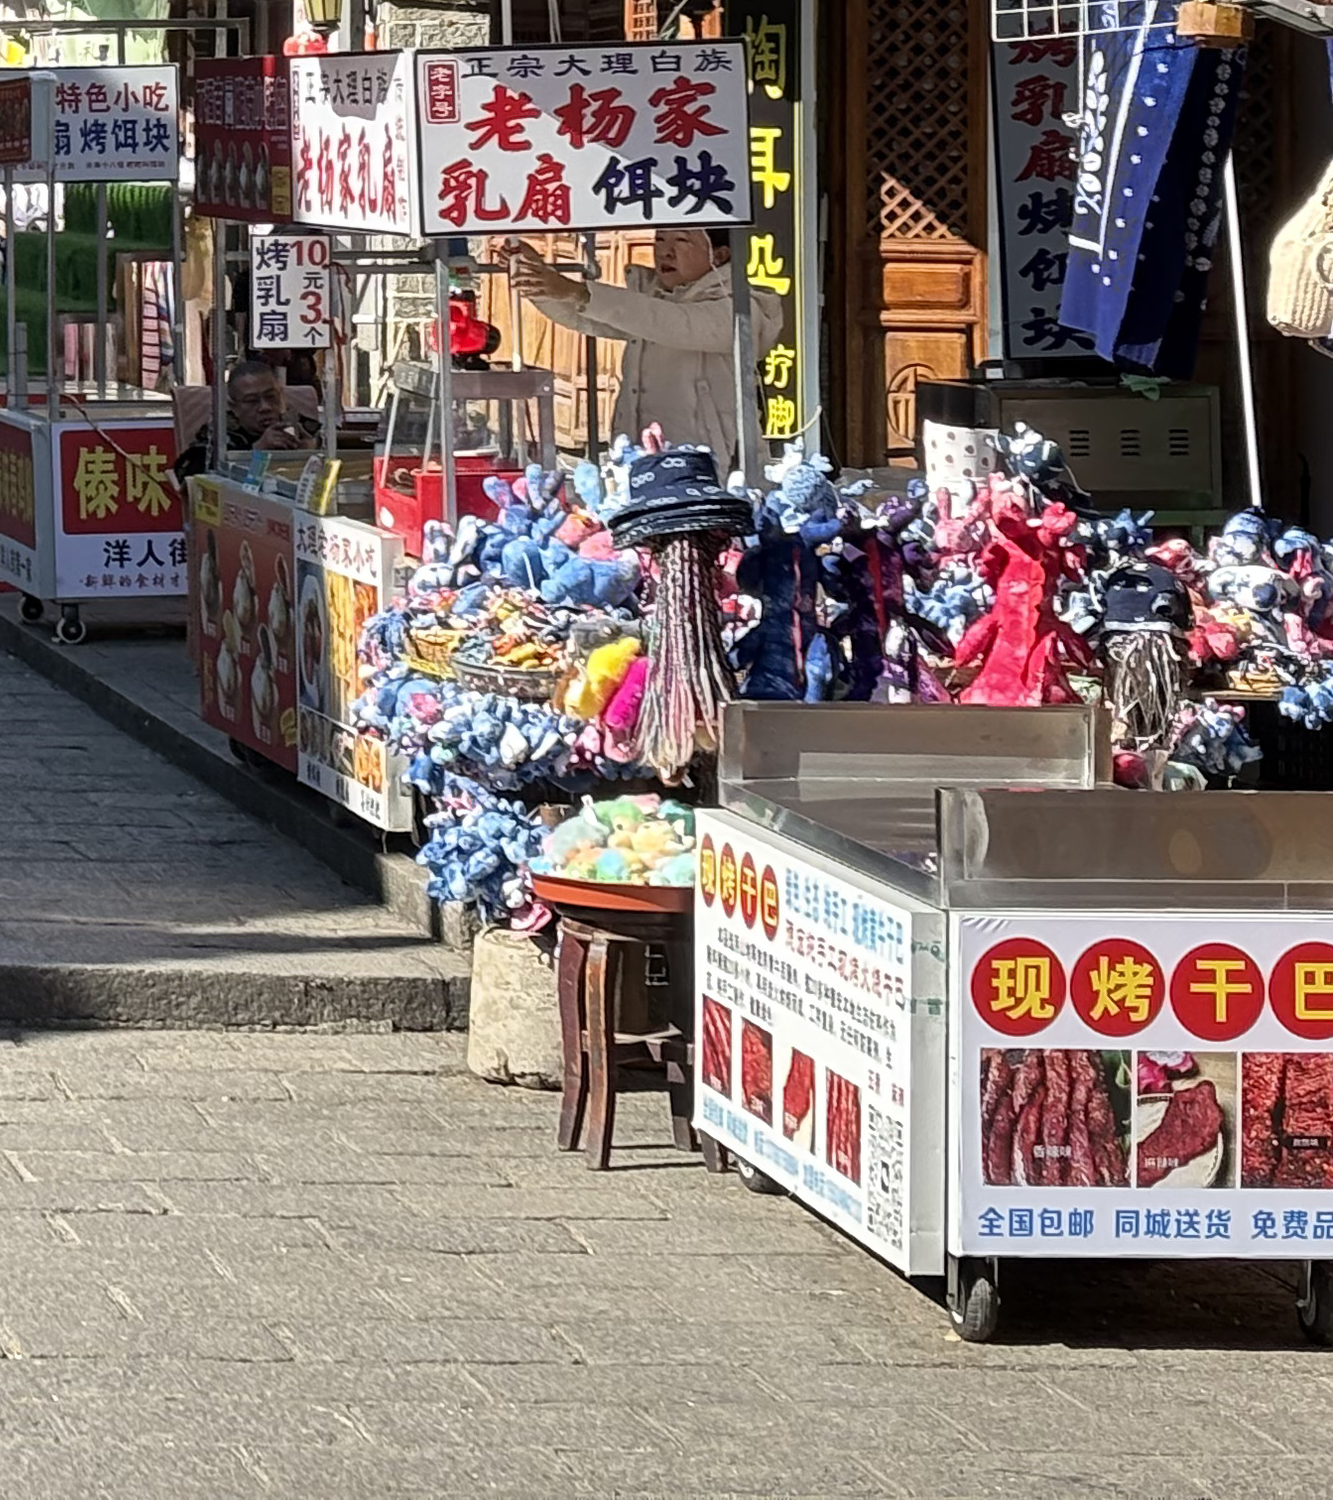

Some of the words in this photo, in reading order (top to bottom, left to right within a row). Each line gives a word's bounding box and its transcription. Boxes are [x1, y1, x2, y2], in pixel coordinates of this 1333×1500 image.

[55, 81, 170, 114] 特色小吃
[429, 64, 454, 119] 老字号
[462, 48, 734, 80] 正宗大理白族
[464, 75, 730, 151] 老杨家
[297, 121, 397, 226] 老杨家乳扇
[437, 152, 573, 228] 乳扇
[590, 149, 737, 221] 饵块
[255, 239, 291, 342] 烤乳扇
[73, 445, 173, 520] 傣味
[84, 571, 188, 589] 新鲜的食材才
[700, 848, 779, 928] 现烤干巴
[991, 956, 1333, 1024] 现烤干巴
[978, 1206, 1095, 1239] 全国包邮
[1114, 1208, 1232, 1240] 同城送货
